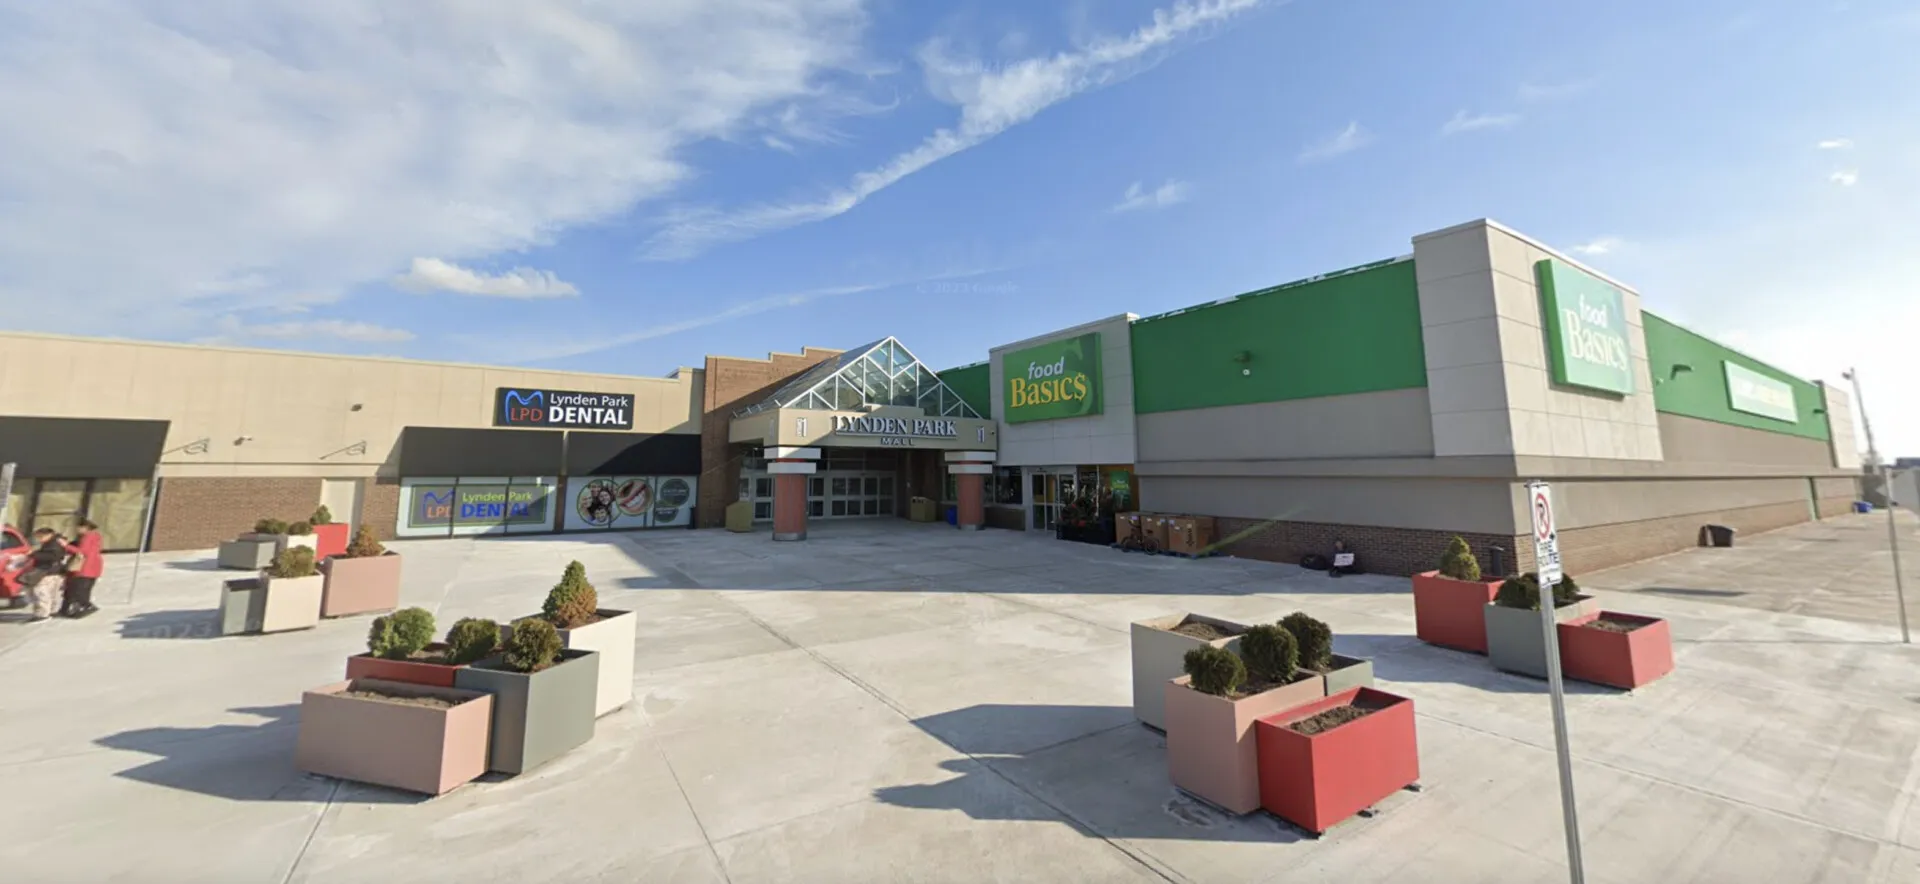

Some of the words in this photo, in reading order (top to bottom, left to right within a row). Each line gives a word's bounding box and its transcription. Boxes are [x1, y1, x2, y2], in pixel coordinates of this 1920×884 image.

[1028, 356, 1065, 380] food
[550, 393, 597, 407] Lynden
[601, 395, 628, 407] Park
[511, 407, 544, 422] LPD
[549, 406, 628, 425] DENTAL
[834, 416, 909, 435] LYNDEN
[912, 419, 958, 436] PARK
[881, 437, 915, 446] MALL
[462, 492, 505, 503] Lynden
[509, 491, 532, 501] Park
